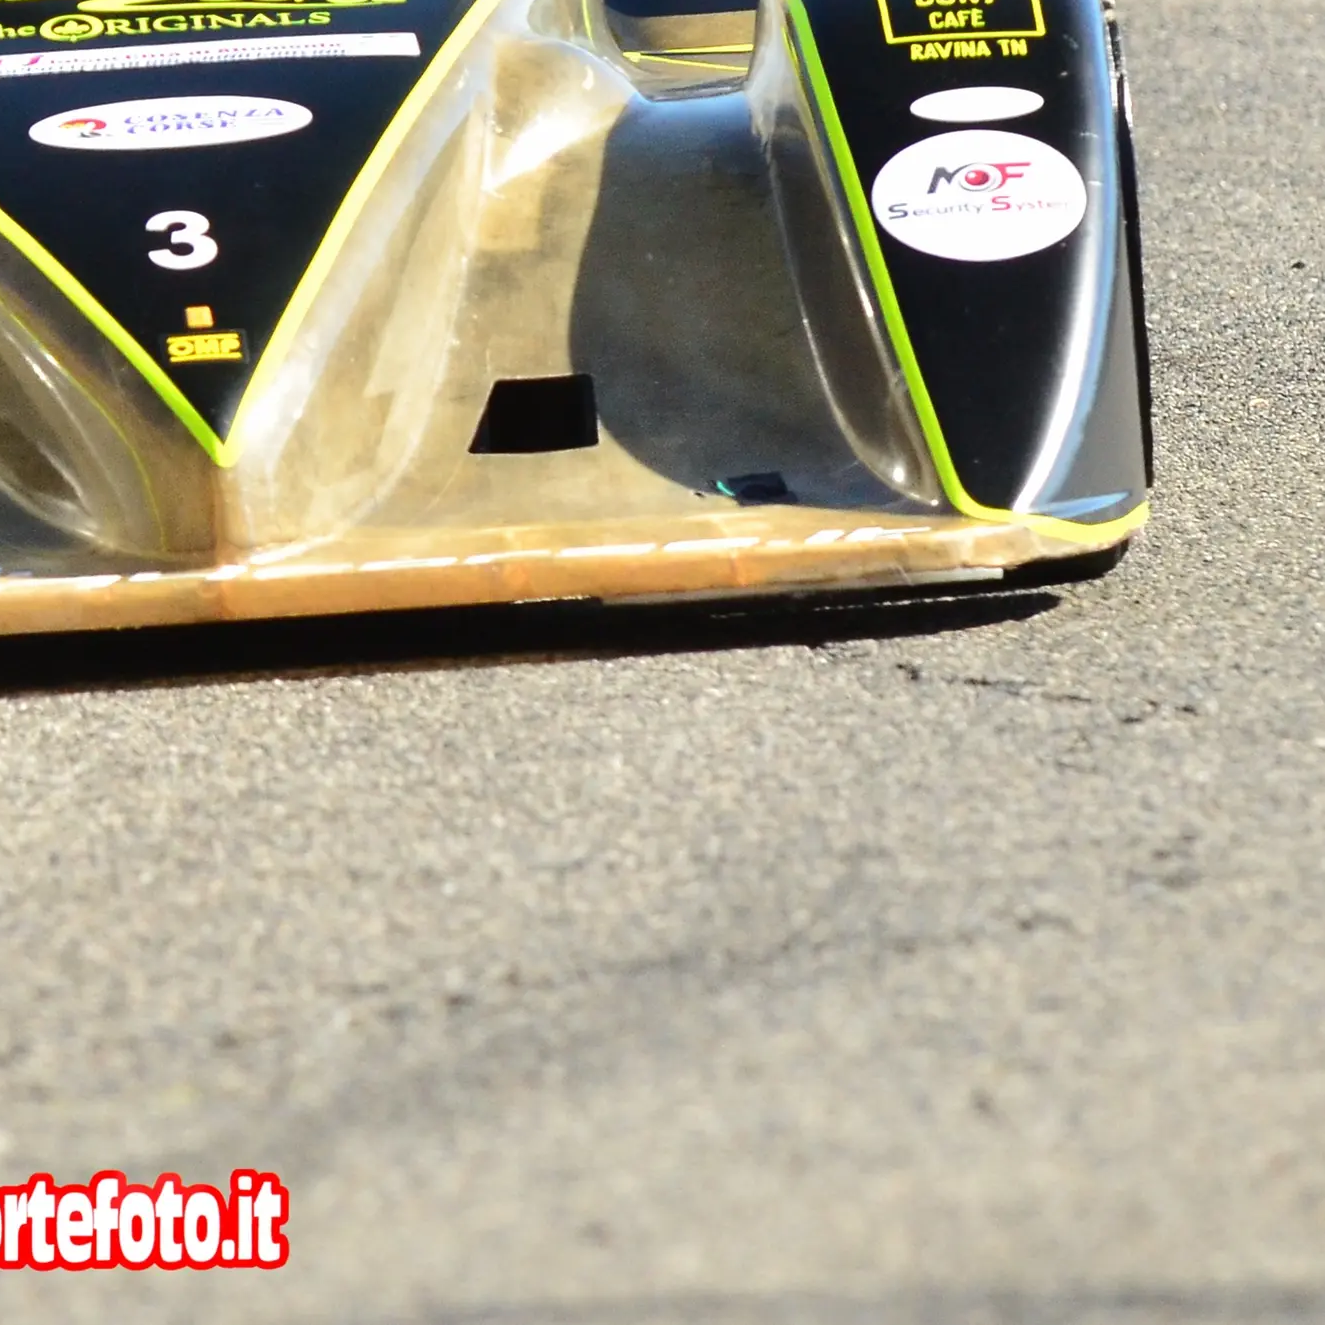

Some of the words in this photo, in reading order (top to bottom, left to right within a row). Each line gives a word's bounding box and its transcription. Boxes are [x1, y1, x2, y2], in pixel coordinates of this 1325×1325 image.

[909, 39, 992, 61] RAVINA
[996, 38, 1028, 57] TN
[123, 107, 285, 125] COSENZA
[126, 118, 237, 135] CORSE
[145, 209, 219, 271] 3
[167, 336, 241, 358] OMP
